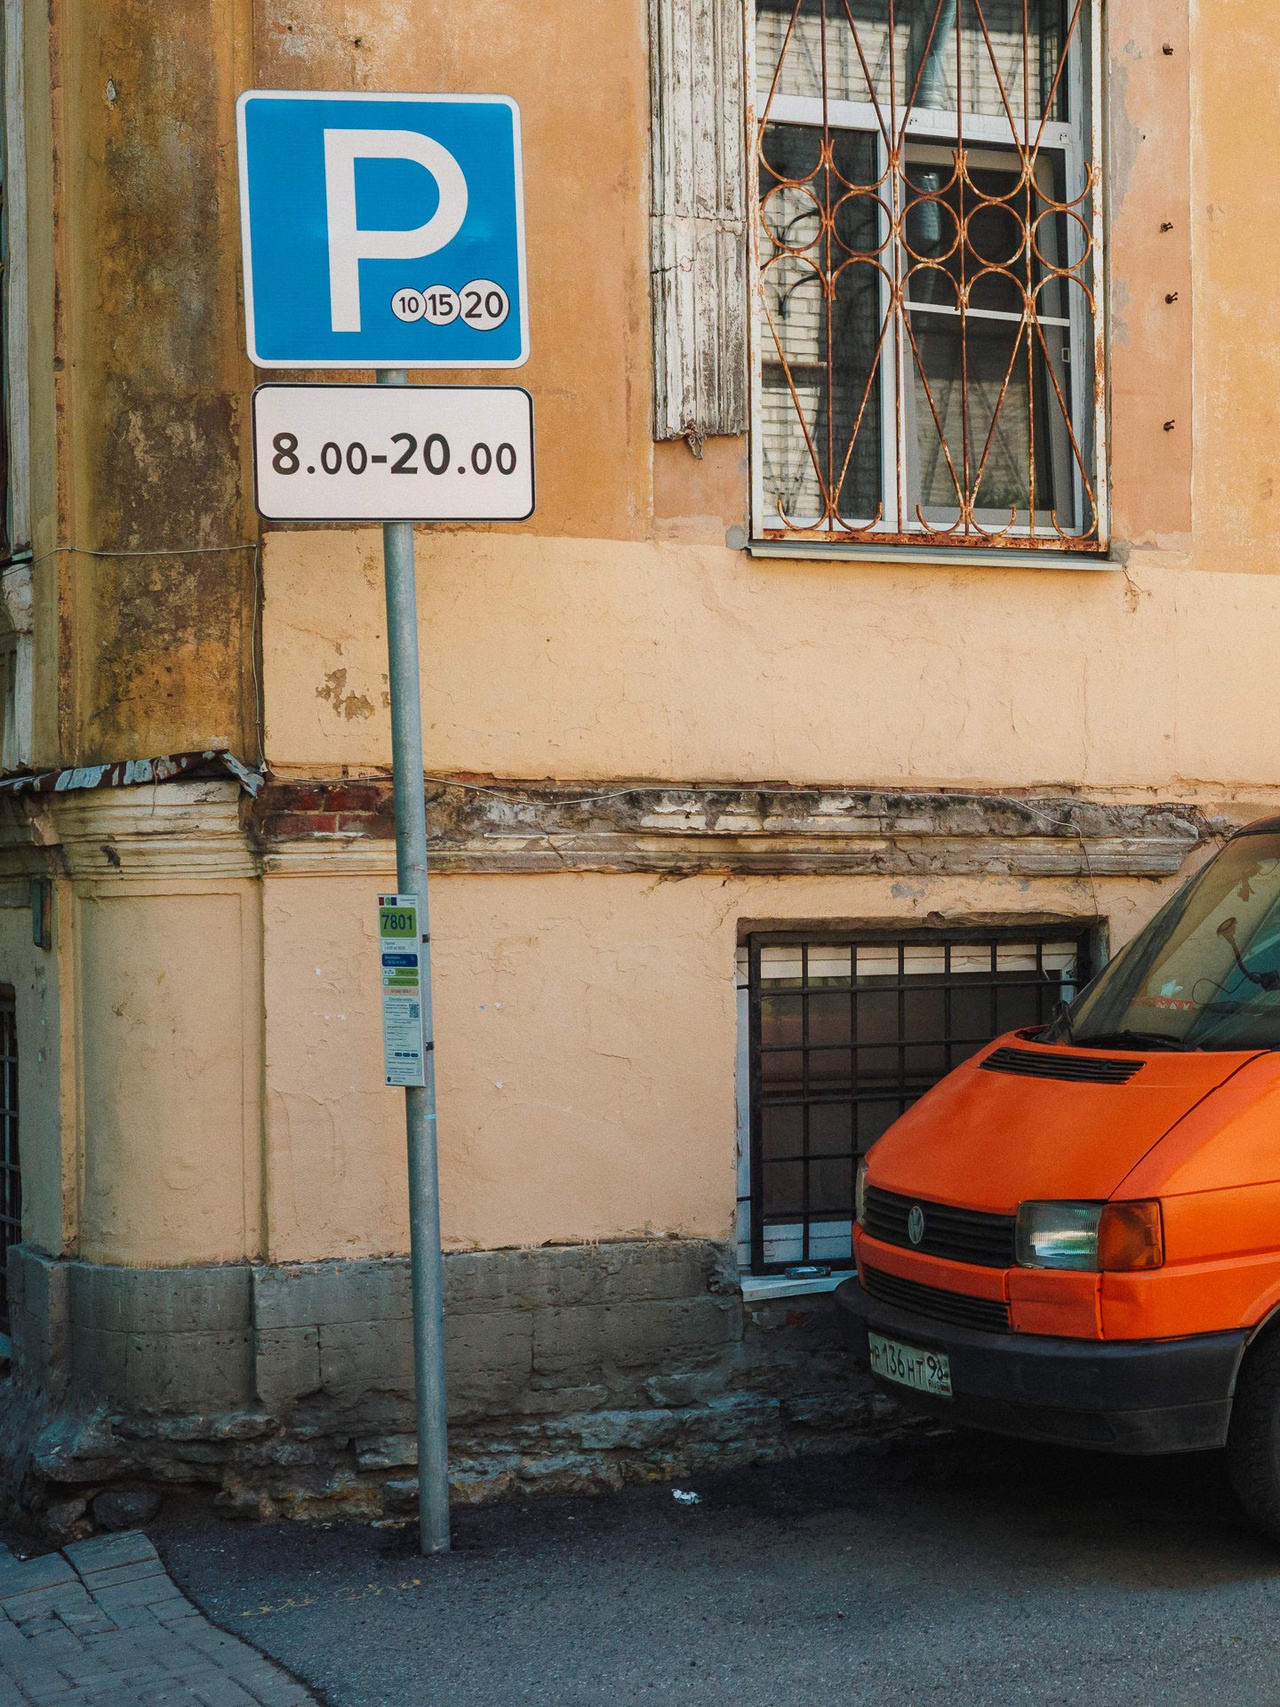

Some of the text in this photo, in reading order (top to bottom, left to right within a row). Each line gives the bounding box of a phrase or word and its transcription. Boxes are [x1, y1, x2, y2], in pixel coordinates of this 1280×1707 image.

[323, 128, 469, 333] P
[398, 290, 502, 319] 10 15 20
[271, 431, 518, 477] 8.00-20.00
[381, 914, 413, 930] 7801
